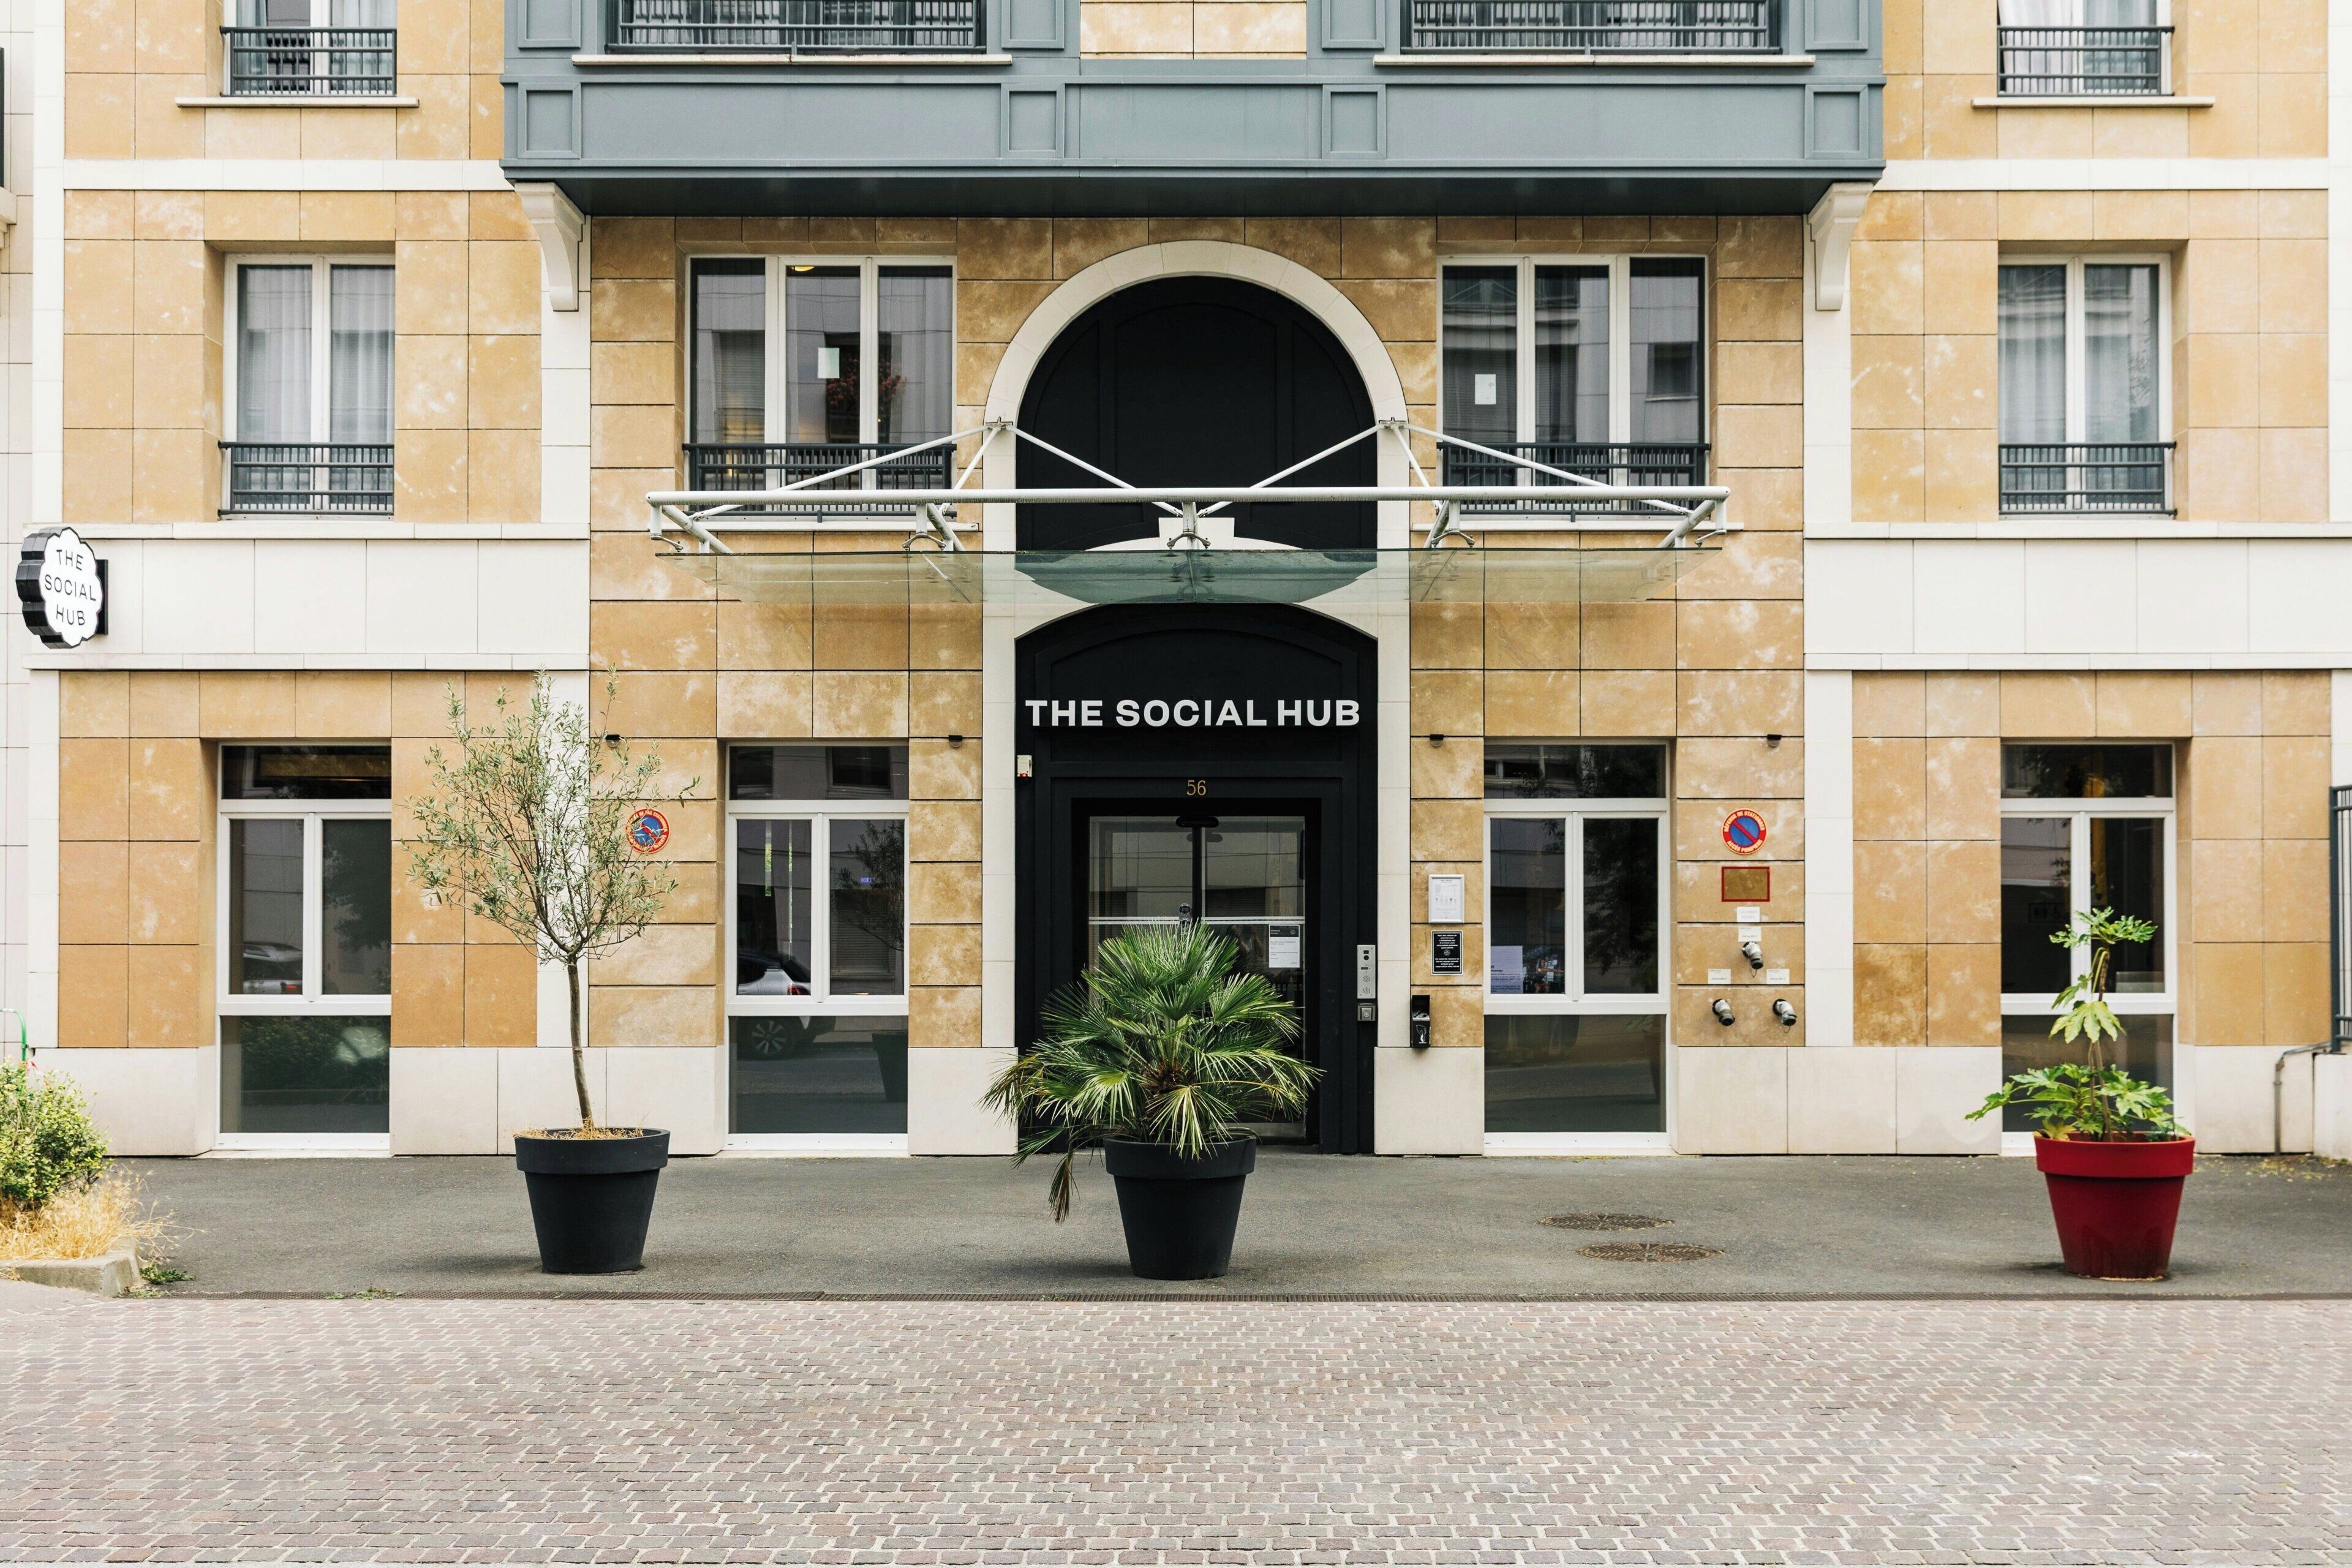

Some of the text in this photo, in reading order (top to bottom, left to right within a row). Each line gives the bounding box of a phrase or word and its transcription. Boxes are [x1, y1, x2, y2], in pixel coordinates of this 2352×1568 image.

[56, 549, 83, 571] THE
[44, 574, 96, 601] SOCIAL
[56, 604, 85, 626] HUB
[1025, 699, 1360, 727] THE SOCIAL HUB
[1186, 780, 1207, 796] 56
[1724, 813, 1738, 832] DÉFENSE
[1744, 810, 1766, 831] STATIONNER
[1727, 839, 1763, 853] ACCÈS POMPIERS
